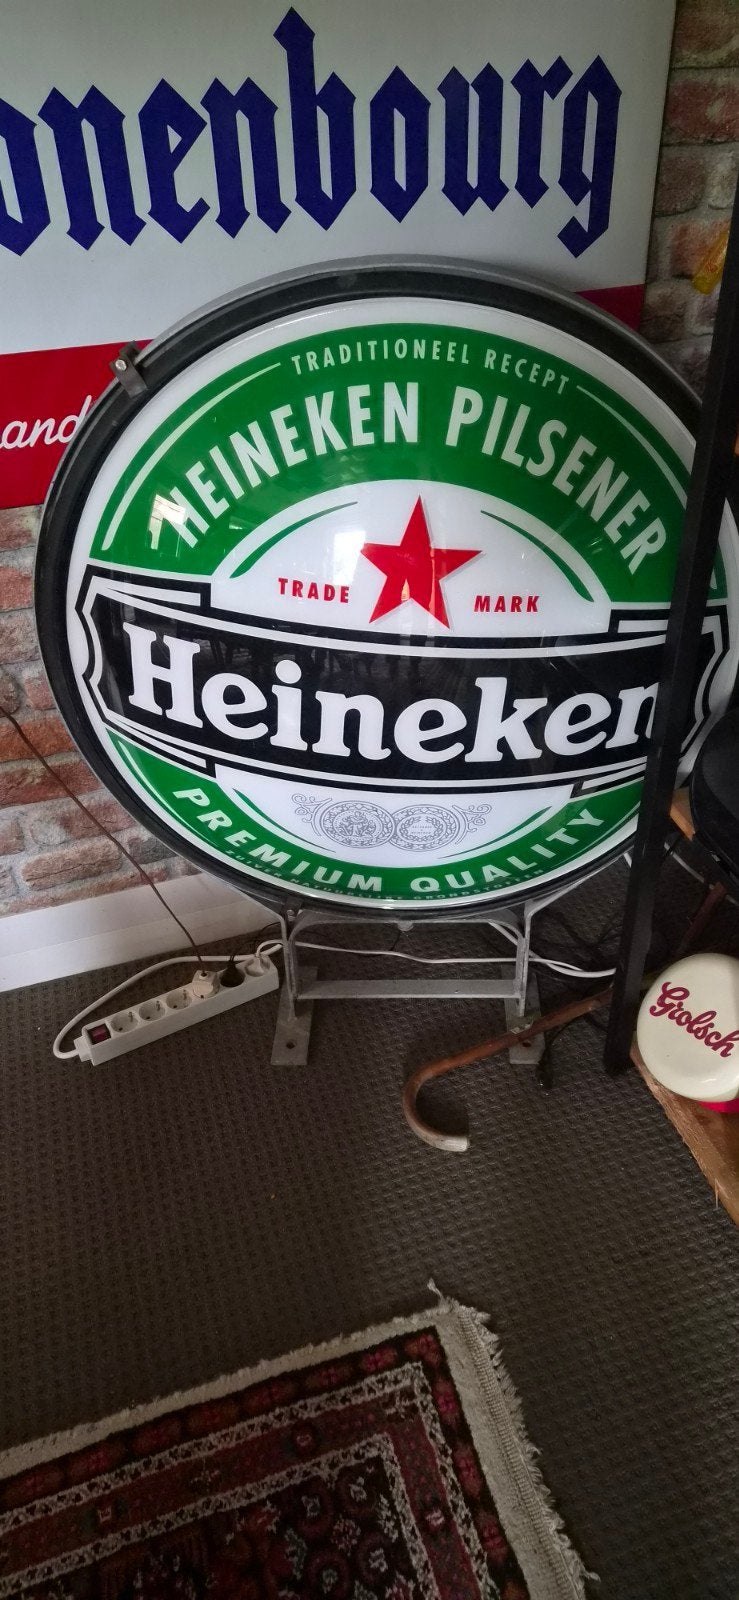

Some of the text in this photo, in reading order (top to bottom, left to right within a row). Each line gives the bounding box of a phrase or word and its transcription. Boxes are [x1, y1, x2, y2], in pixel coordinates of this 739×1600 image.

[291, 338, 570, 395] TRADITIONEEL RECEPT
[162, 382, 667, 575] HEINEKEN PILSENER
[278, 577, 539, 613] TRADE MARK
[173, 789, 605, 894] PREMIUM QUALITY
[649, 981, 739, 1057] Grolsch
